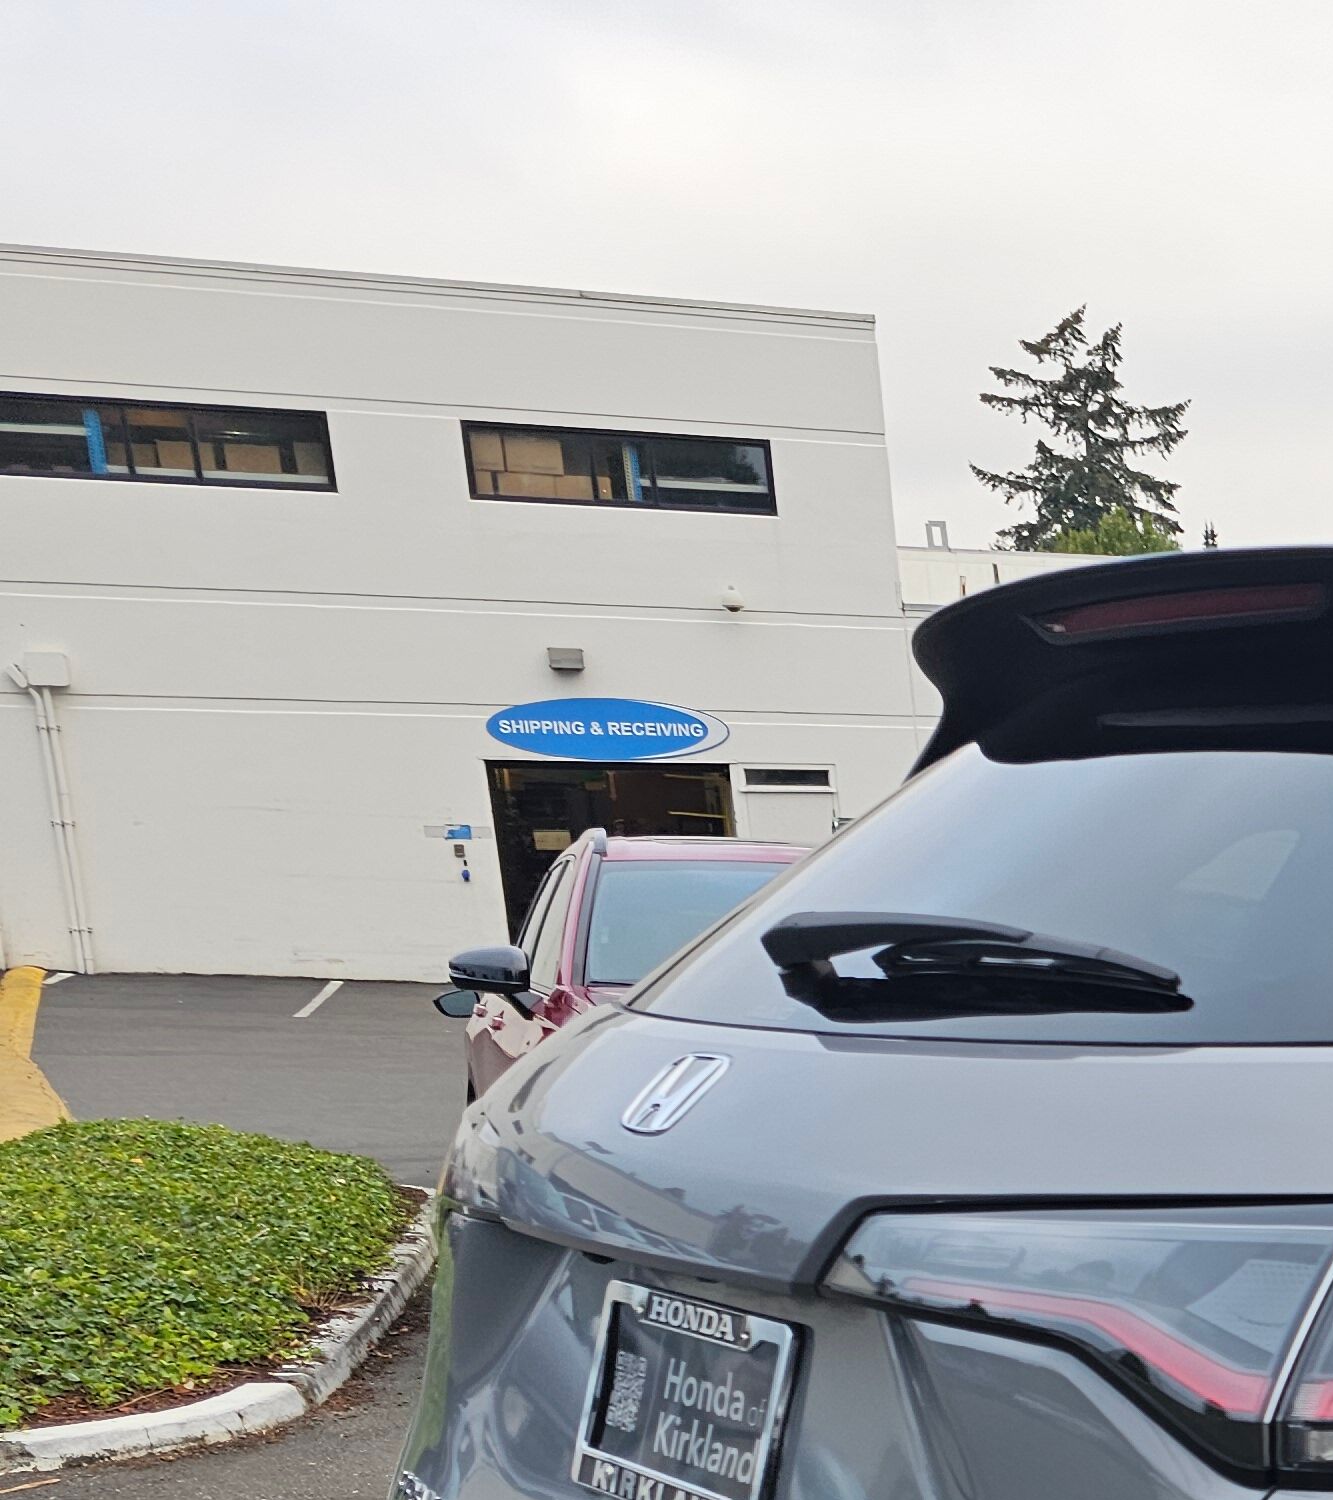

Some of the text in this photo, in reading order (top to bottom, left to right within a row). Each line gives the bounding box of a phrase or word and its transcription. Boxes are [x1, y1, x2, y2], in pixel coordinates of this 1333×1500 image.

[498, 719, 704, 738] SHIPPING & RECEIVING
[647, 1295, 735, 1342] HONDA
[663, 1357, 746, 1423] Honda
[652, 1410, 757, 1486] Kirkland
